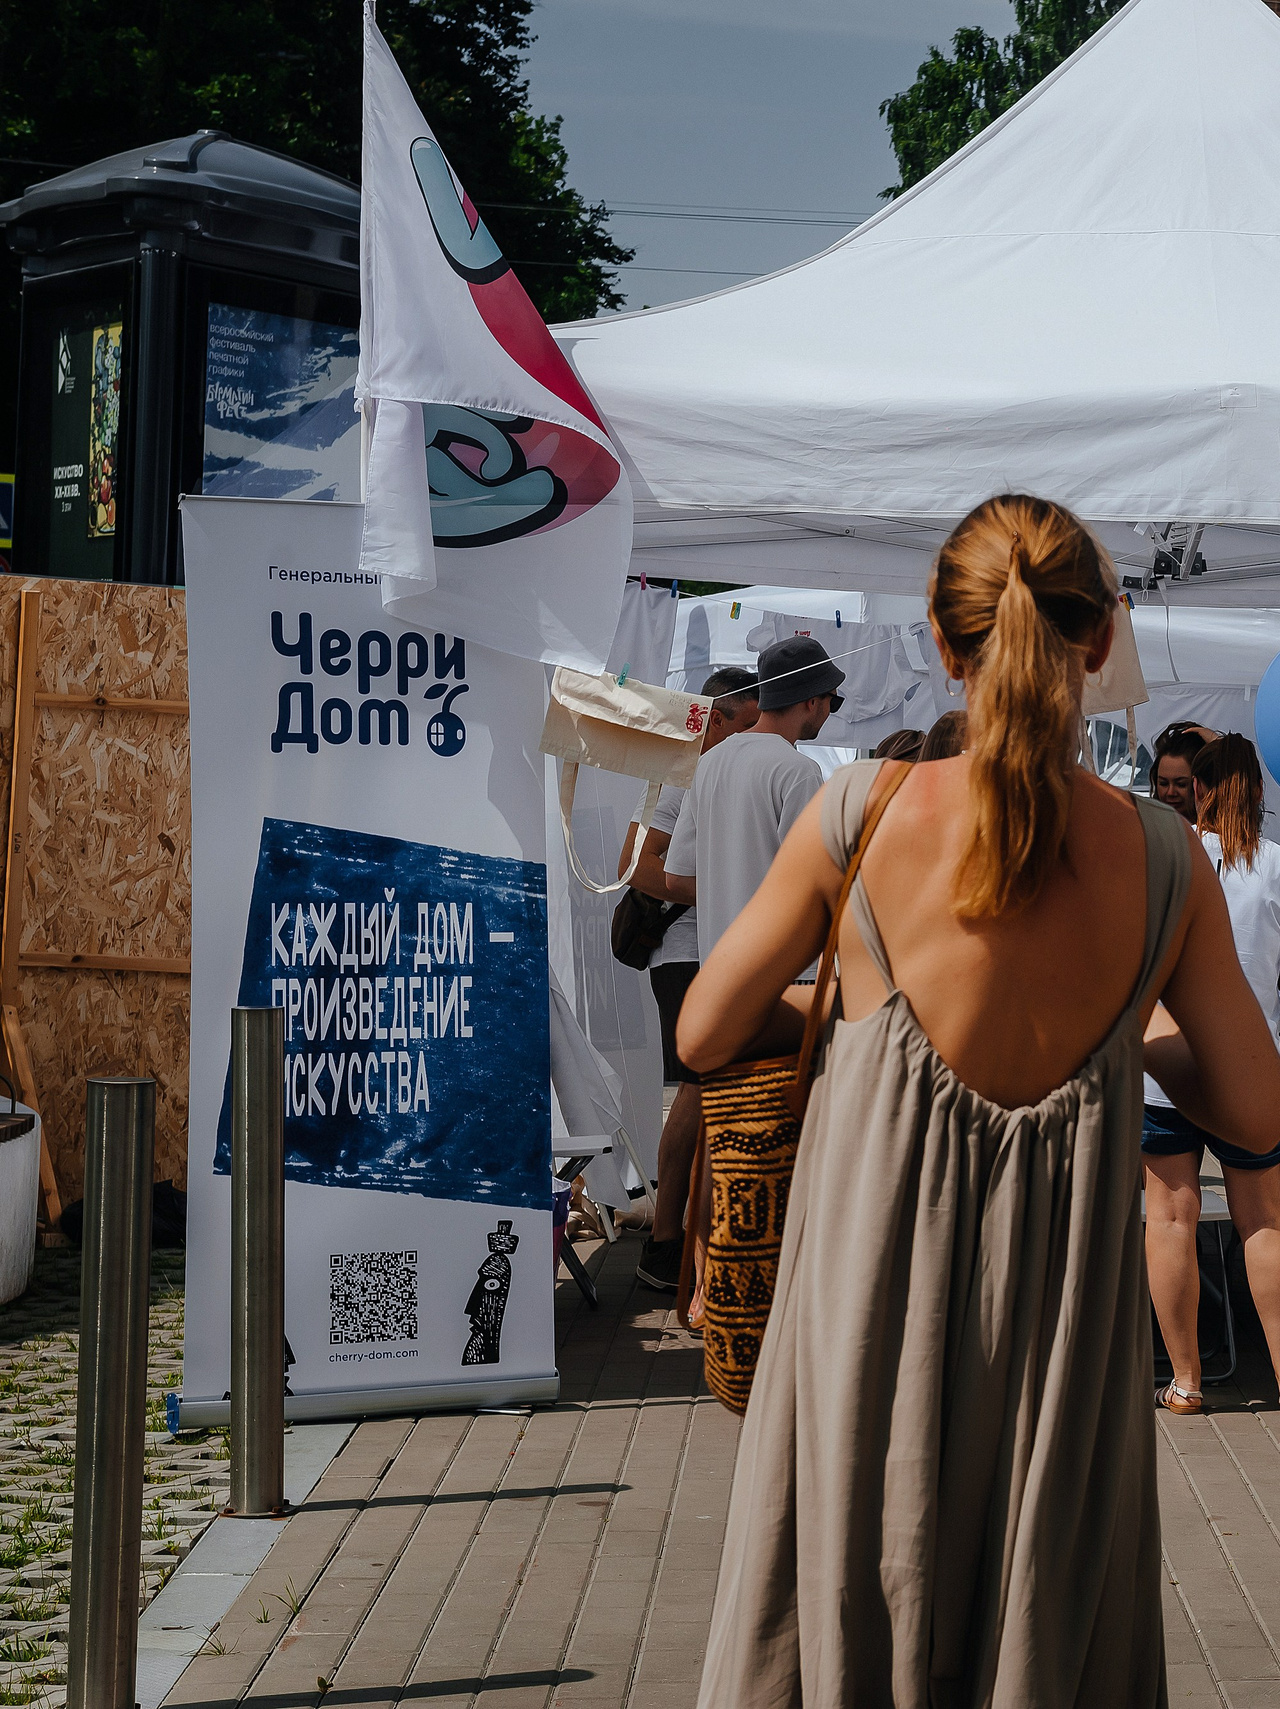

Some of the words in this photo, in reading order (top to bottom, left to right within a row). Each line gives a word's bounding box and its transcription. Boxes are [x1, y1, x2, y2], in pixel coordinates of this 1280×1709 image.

[209, 336, 257, 353] фестиваль
[208, 351, 249, 365] печатной
[208, 364, 245, 378] графики
[268, 565, 382, 585] Генеральны
[270, 610, 466, 696] Черри
[270, 681, 410, 754] Дом
[271, 887, 400, 974] КАЖДЫЙ
[414, 902, 474, 973] ДОМ
[271, 976, 473, 1048] ПРОИЗВЕДЕНИЕ
[328, 1349, 419, 1363] cherry-dom.com
